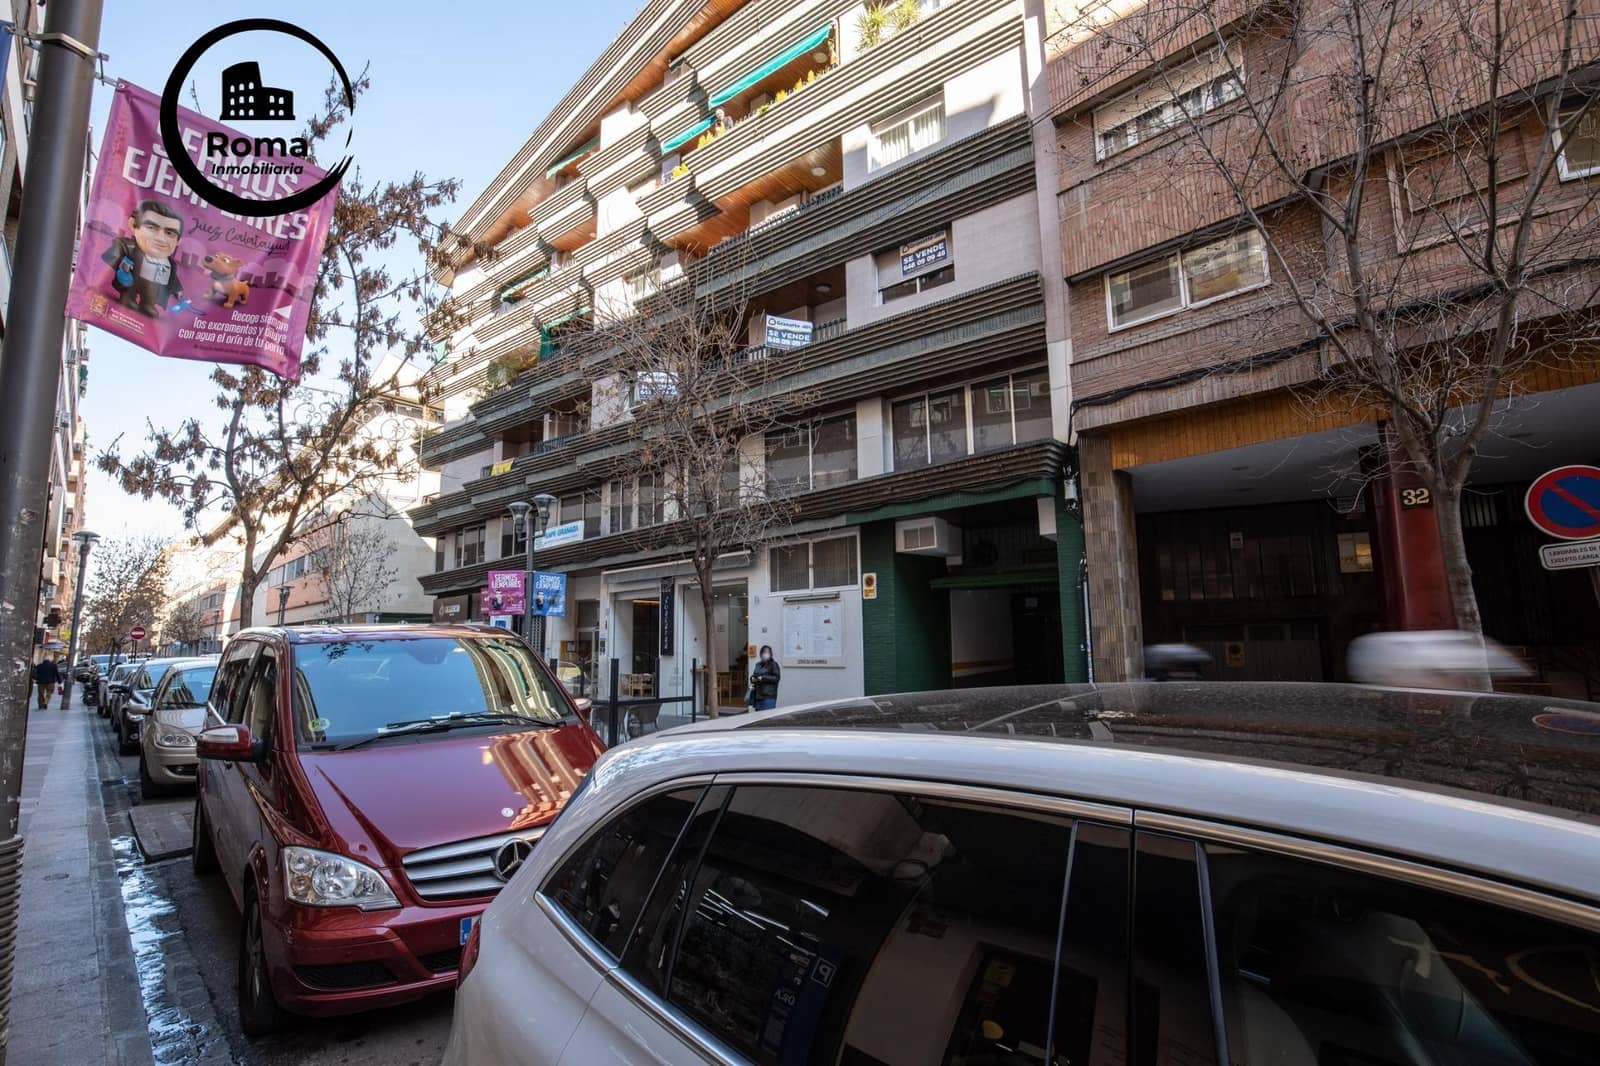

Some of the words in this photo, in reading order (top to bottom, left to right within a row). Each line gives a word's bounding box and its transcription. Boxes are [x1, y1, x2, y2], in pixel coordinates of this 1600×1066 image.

[153, 122, 299, 198] EAMOS
[903, 255, 914, 265] SE
[915, 242, 945, 259] VENDE
[193, 316, 208, 329] los
[207, 321, 257, 335] excrementos
[231, 310, 260, 323] Recoge
[195, 331, 216, 343] agua
[216, 332, 226, 343] el
[226, 334, 243, 345] orín
[243, 335, 253, 346] de
[254, 337, 264, 348] tu
[780, 331, 811, 342] VENDE
[1402, 487, 1430, 506] 32
